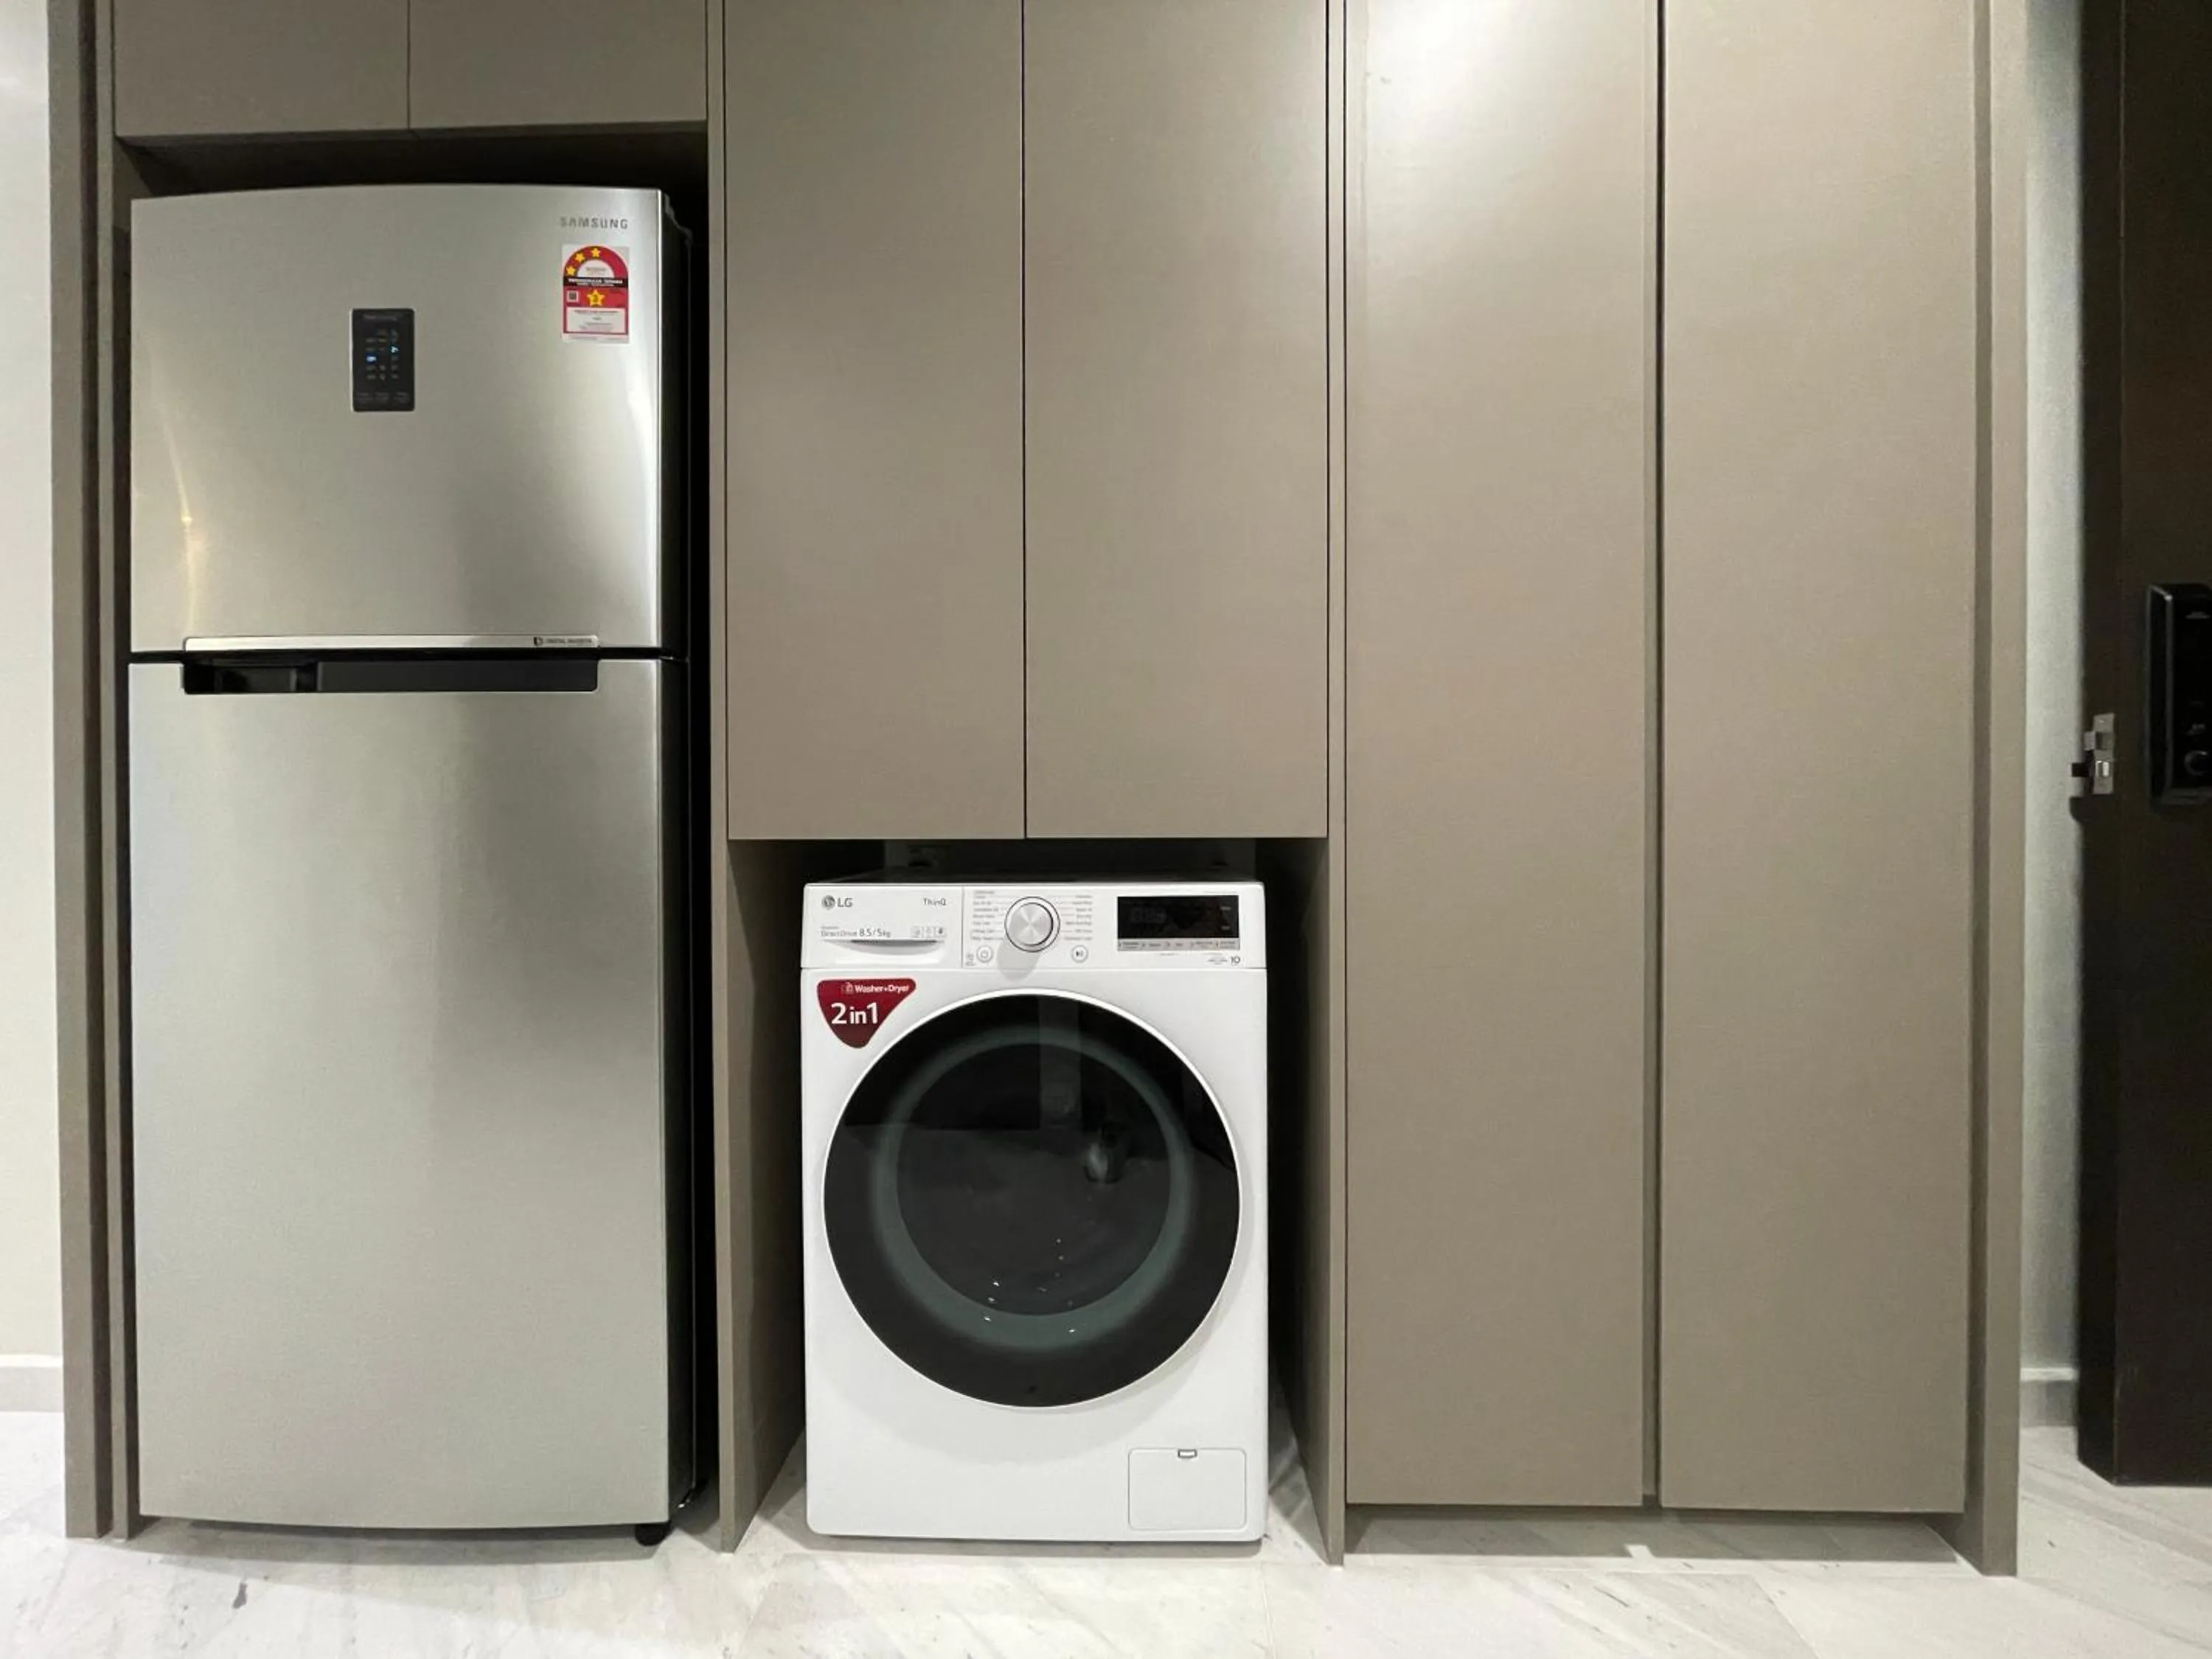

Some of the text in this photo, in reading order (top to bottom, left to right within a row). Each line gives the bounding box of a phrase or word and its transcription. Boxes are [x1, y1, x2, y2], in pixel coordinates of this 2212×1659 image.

[559, 216, 629, 229] SAMSUNG
[837, 897, 853, 908] LG
[923, 897, 947, 907] ThinQ
